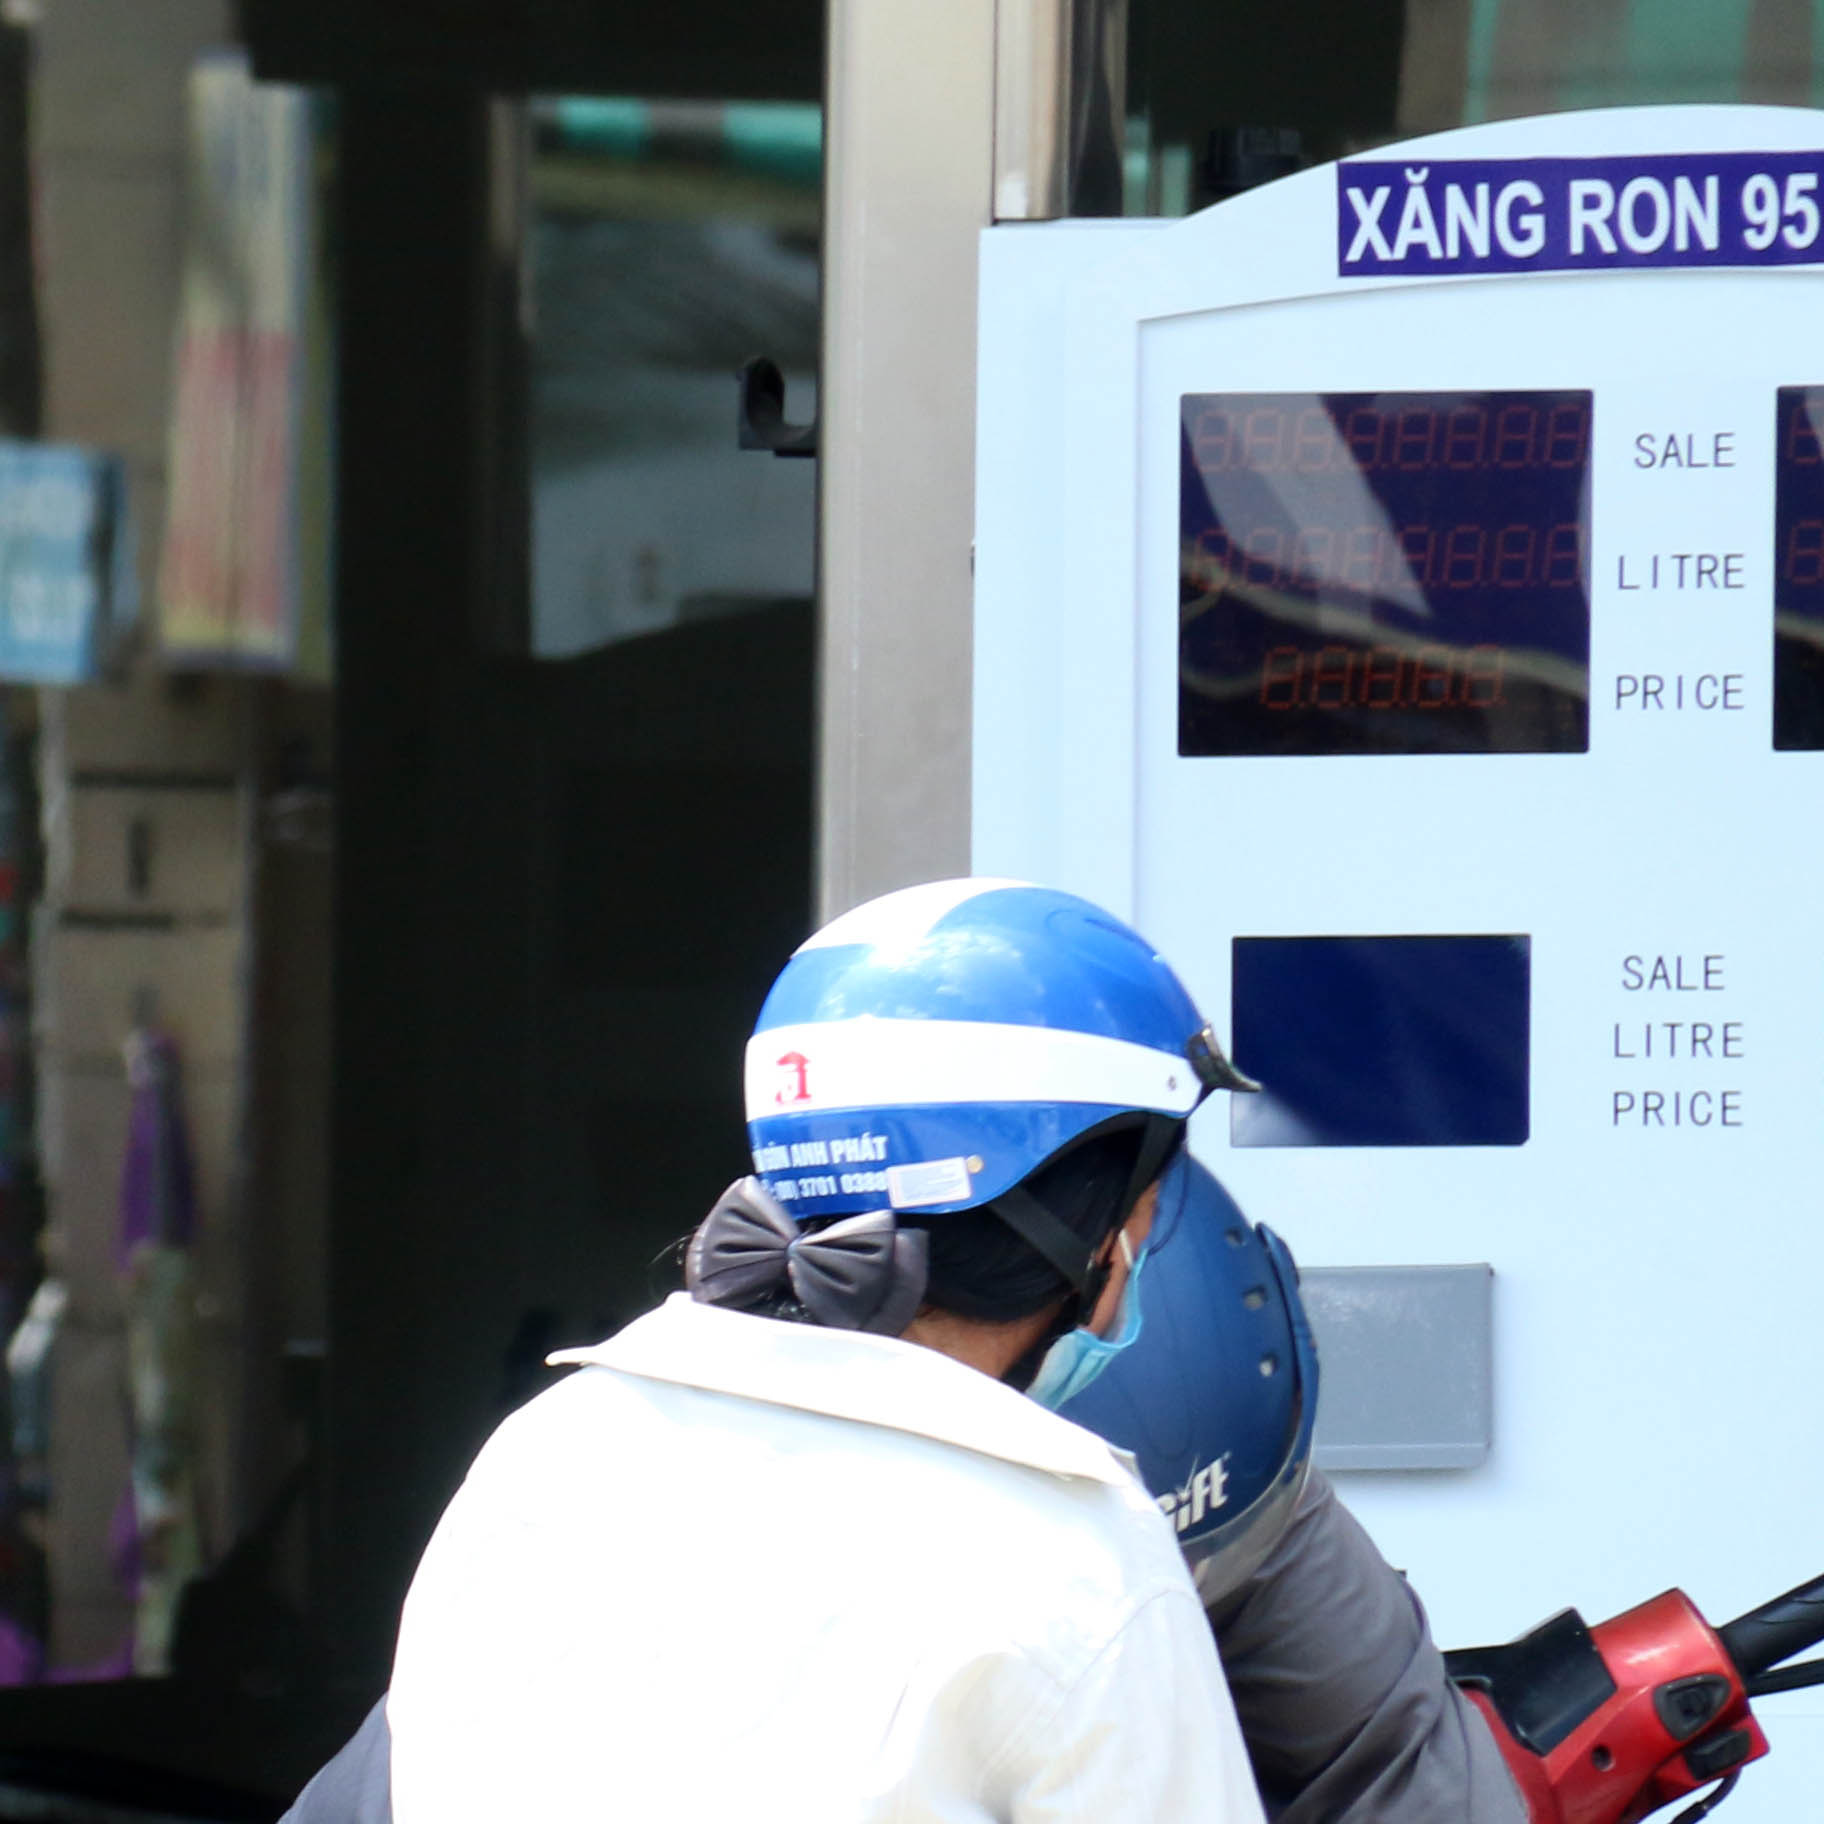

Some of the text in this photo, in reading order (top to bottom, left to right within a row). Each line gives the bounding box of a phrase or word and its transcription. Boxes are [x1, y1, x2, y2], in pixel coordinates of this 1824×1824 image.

[1345, 168, 1820, 262] XĂNG RON 95
[1633, 431, 1737, 470] SALE
[1617, 552, 1746, 591] LITRE
[1615, 673, 1745, 711] PRICE
[1621, 954, 1726, 992] SALE
[1613, 1021, 1745, 1059] LITRE
[1612, 1089, 1744, 1128] PRICE
